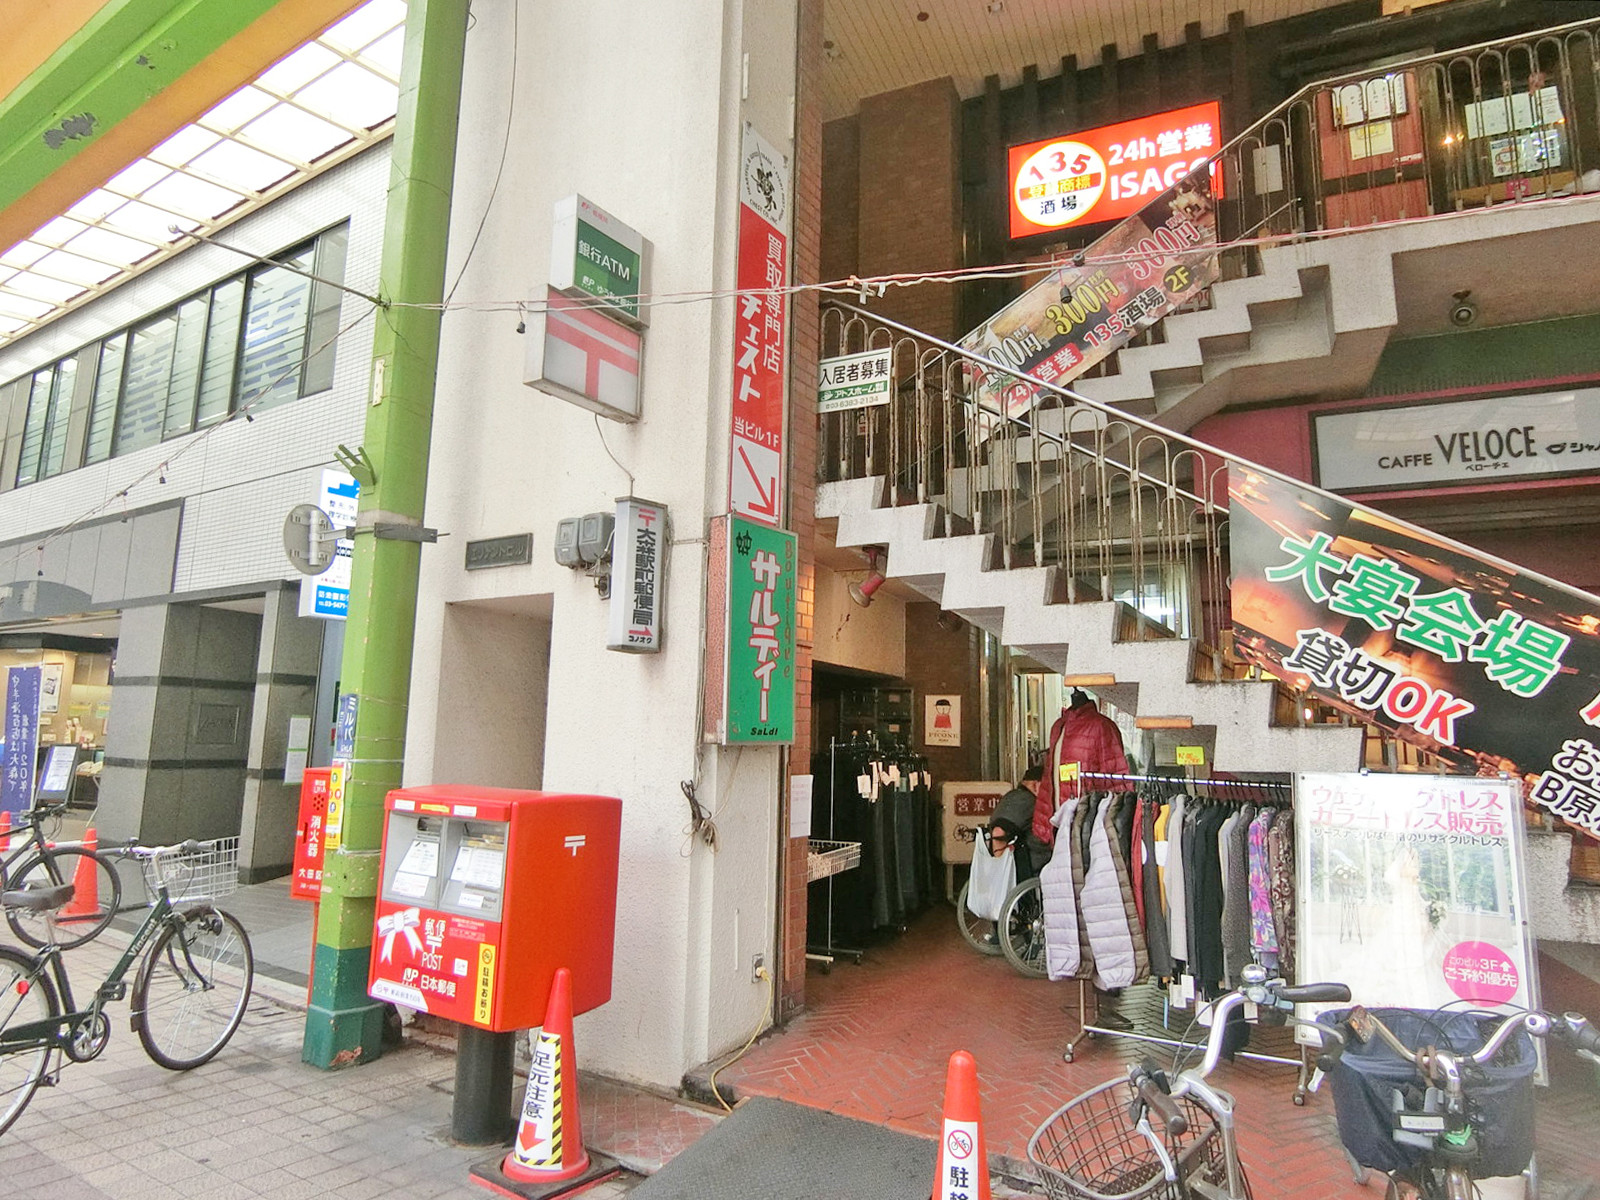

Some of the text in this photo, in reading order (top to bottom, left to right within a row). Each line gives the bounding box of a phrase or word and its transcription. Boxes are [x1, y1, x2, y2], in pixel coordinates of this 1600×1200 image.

[1108, 123, 1212, 166] 24h営業
[1029, 151, 1091, 182] 135
[1040, 195, 1078, 215] 酒場
[578, 240, 630, 280] 銀行ATM
[1045, 277, 1120, 335] 300円
[1123, 221, 1200, 280] 500円
[763, 233, 782, 374] 買取専門店
[1084, 286, 1167, 349] 135酒場
[1164, 265, 1190, 292] 2F
[737, 294, 762, 402] チェスト
[819, 358, 889, 387] 入居者募集
[734, 416, 779, 447] 当ビル1F
[1378, 426, 1537, 469] CAFFE VELOCE
[1465, 462, 1510, 472] ベローチェ
[632, 528, 656, 626] 大森駅前郵便局
[749, 549, 782, 722] サルディー
[1264, 532, 1571, 698] 大宴会場
[1282, 628, 1475, 746] 貸切OK
[1553, 739, 1600, 788] お
[307, 815, 322, 858] 消火器
[425, 918, 446, 939] 郵便
[421, 951, 443, 971] POST
[1445, 967, 1517, 988] ご予約優先
[420, 974, 457, 998] 日本郵便
[525, 1050, 551, 1119] 足元注意
